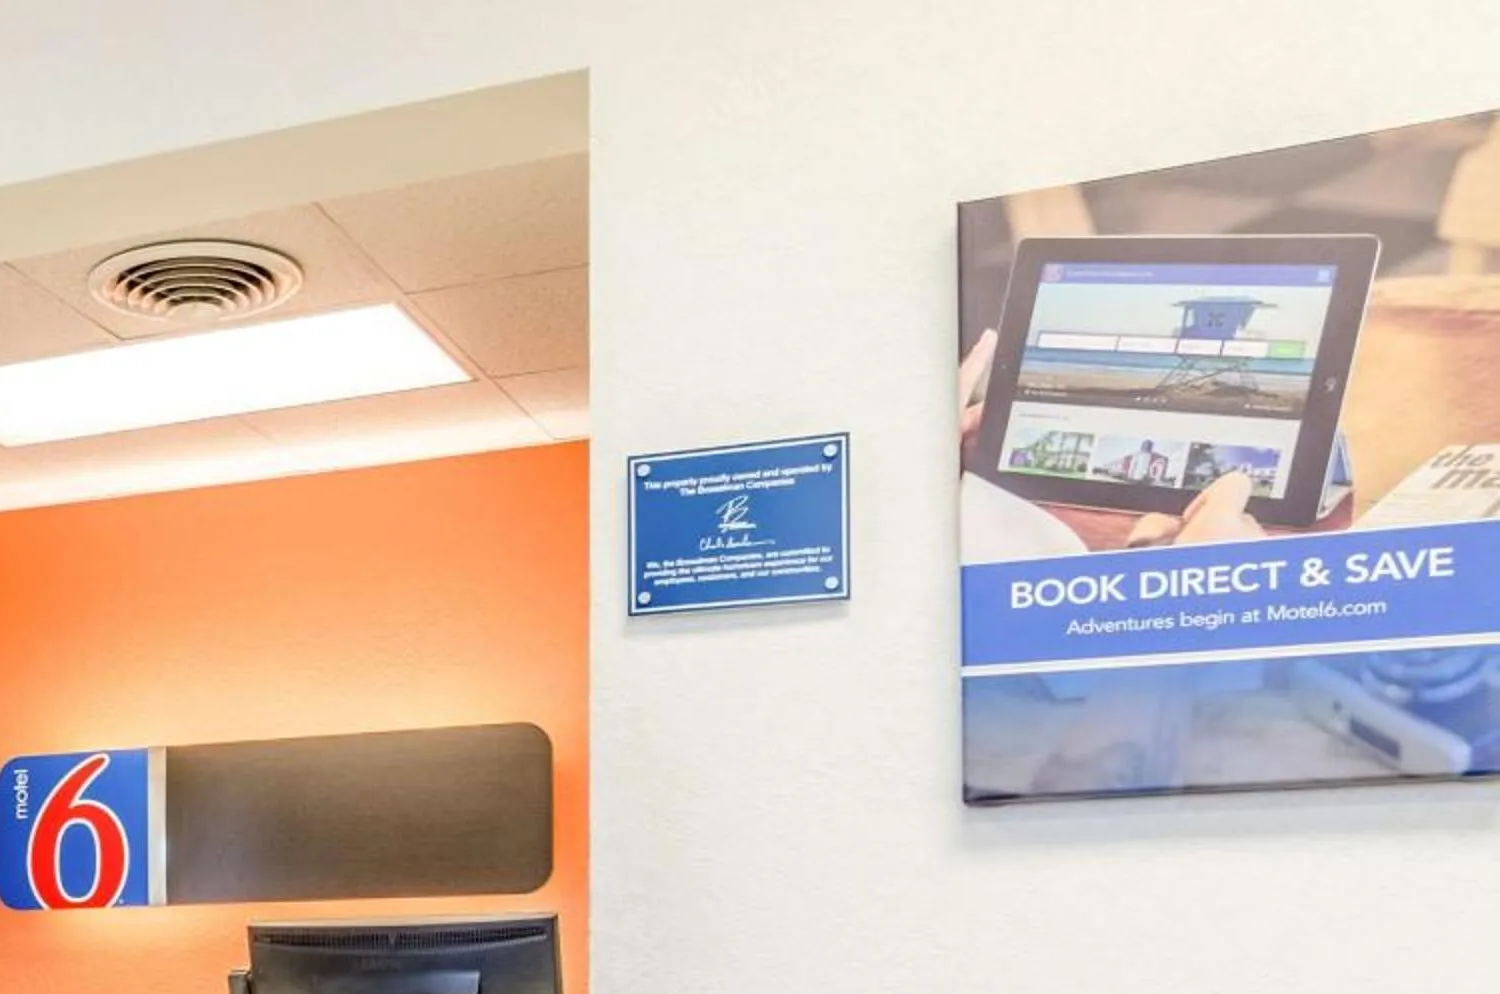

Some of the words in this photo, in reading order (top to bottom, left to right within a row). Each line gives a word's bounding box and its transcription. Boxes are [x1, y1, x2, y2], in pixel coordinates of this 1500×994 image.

[680, 486, 696, 496] The
[763, 467, 779, 477] and
[821, 463, 833, 475] by
[1011, 573, 1127, 609] BOOK
[1139, 560, 1288, 600] DIRECT
[1300, 557, 1331, 588] &
[1345, 546, 1455, 584] SAVE
[1066, 617, 1175, 635] Adventures
[1180, 609, 1235, 630] begin
[1241, 608, 1261, 623] at
[1267, 600, 1387, 621] Motel6.com
[13, 769, 29, 819] motel
[27, 753, 129, 910] 6
